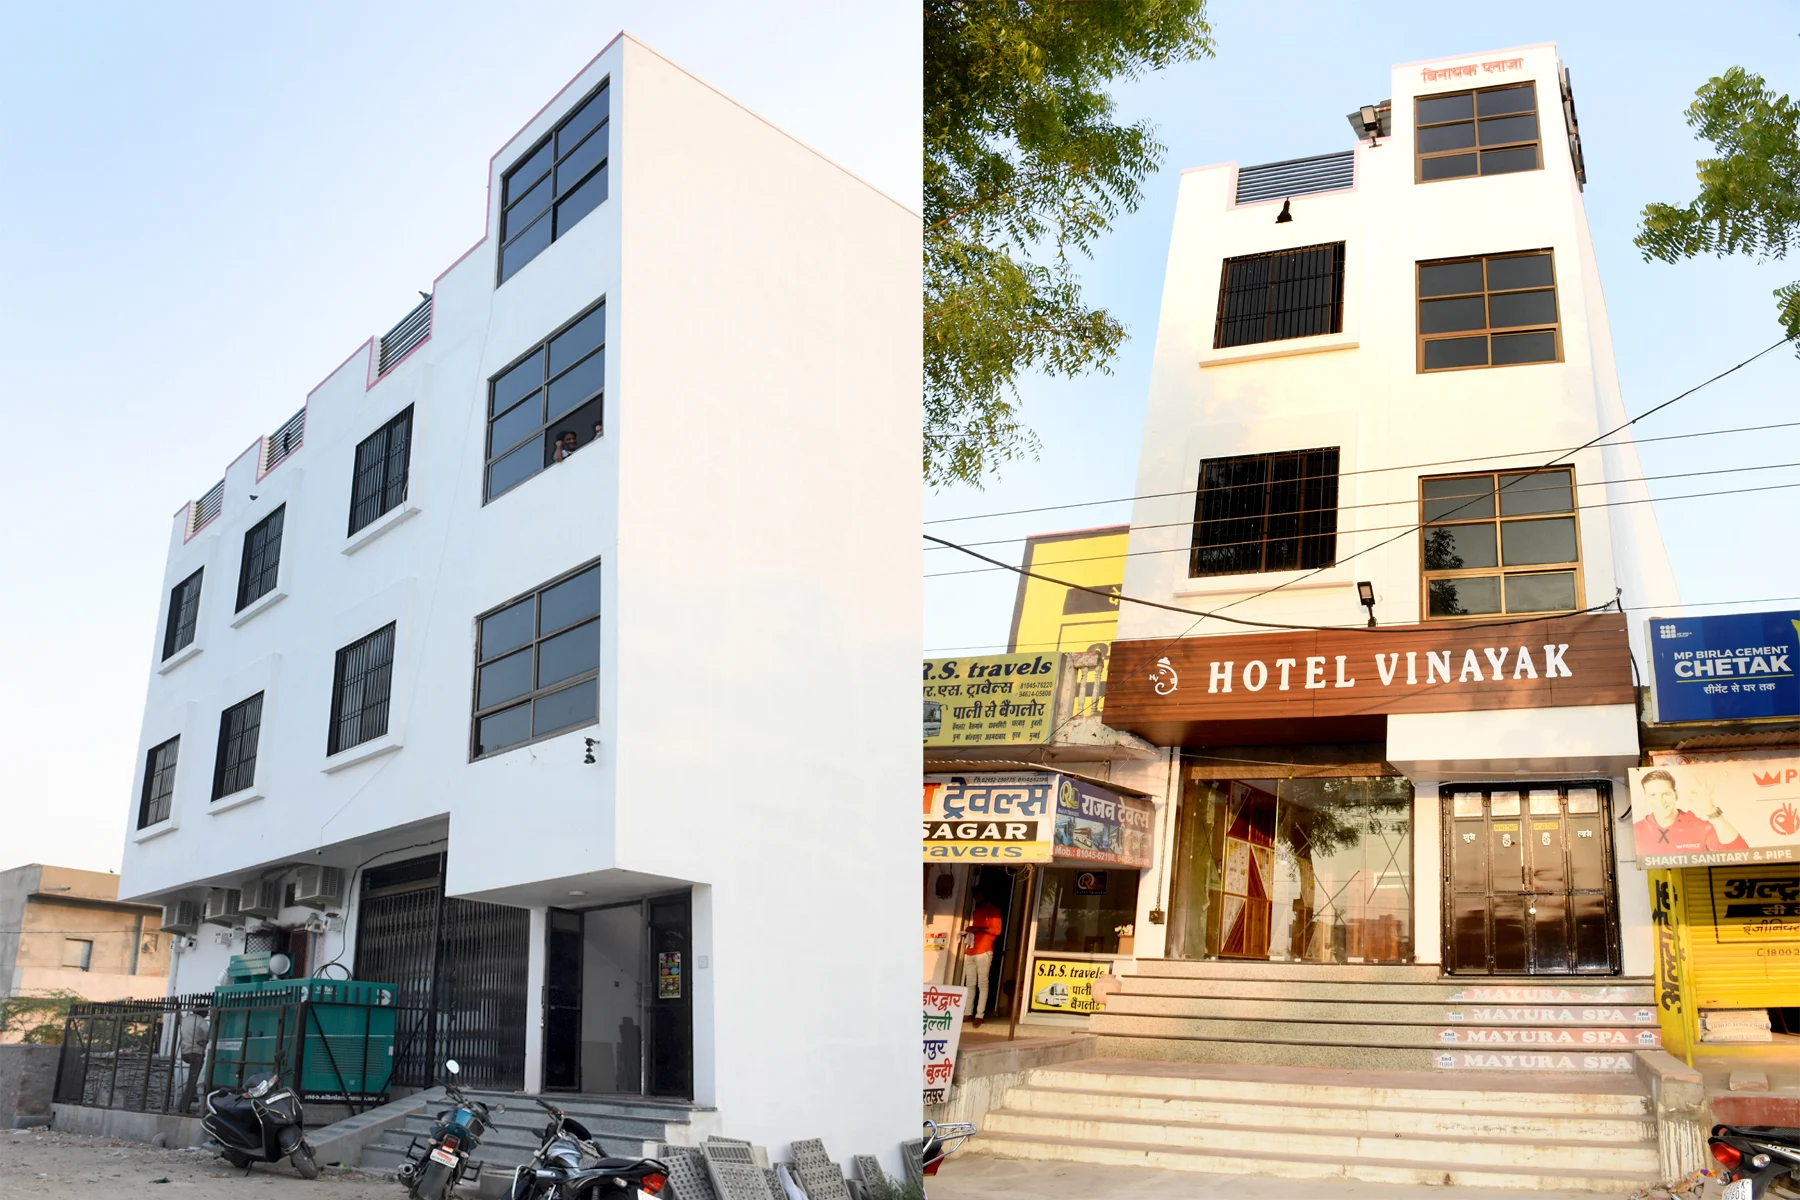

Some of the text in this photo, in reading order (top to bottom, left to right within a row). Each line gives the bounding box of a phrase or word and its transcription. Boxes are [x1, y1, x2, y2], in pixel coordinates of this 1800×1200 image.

[1674, 645, 1788, 660] MP BIRLA CEMENT
[967, 656, 1053, 678] travels
[1207, 643, 1573, 694] HOTEL VINAYAK
[1674, 655, 1792, 678] CHETAK
[1731, 682, 1740, 693] से
[1743, 683, 1756, 692] घर
[1759, 682, 1776, 691] तक
[953, 699, 1046, 719] पाली से बैंगलोर
[1785, 768, 1800, 784] P
[943, 776, 1053, 820] ट्रेवल्स
[1081, 794, 1117, 821] राजन
[1644, 849, 1792, 866] SHAKTI SANITARY & PIPE
[1037, 963, 1068, 977] S.R.S.
[1473, 988, 1572, 1001] MAYURA
[1472, 1008, 1628, 1021] MAYURA SPA
[1466, 1030, 1629, 1043] MAYURA SPA
[1463, 1055, 1633, 1069] MAYURA SPA
